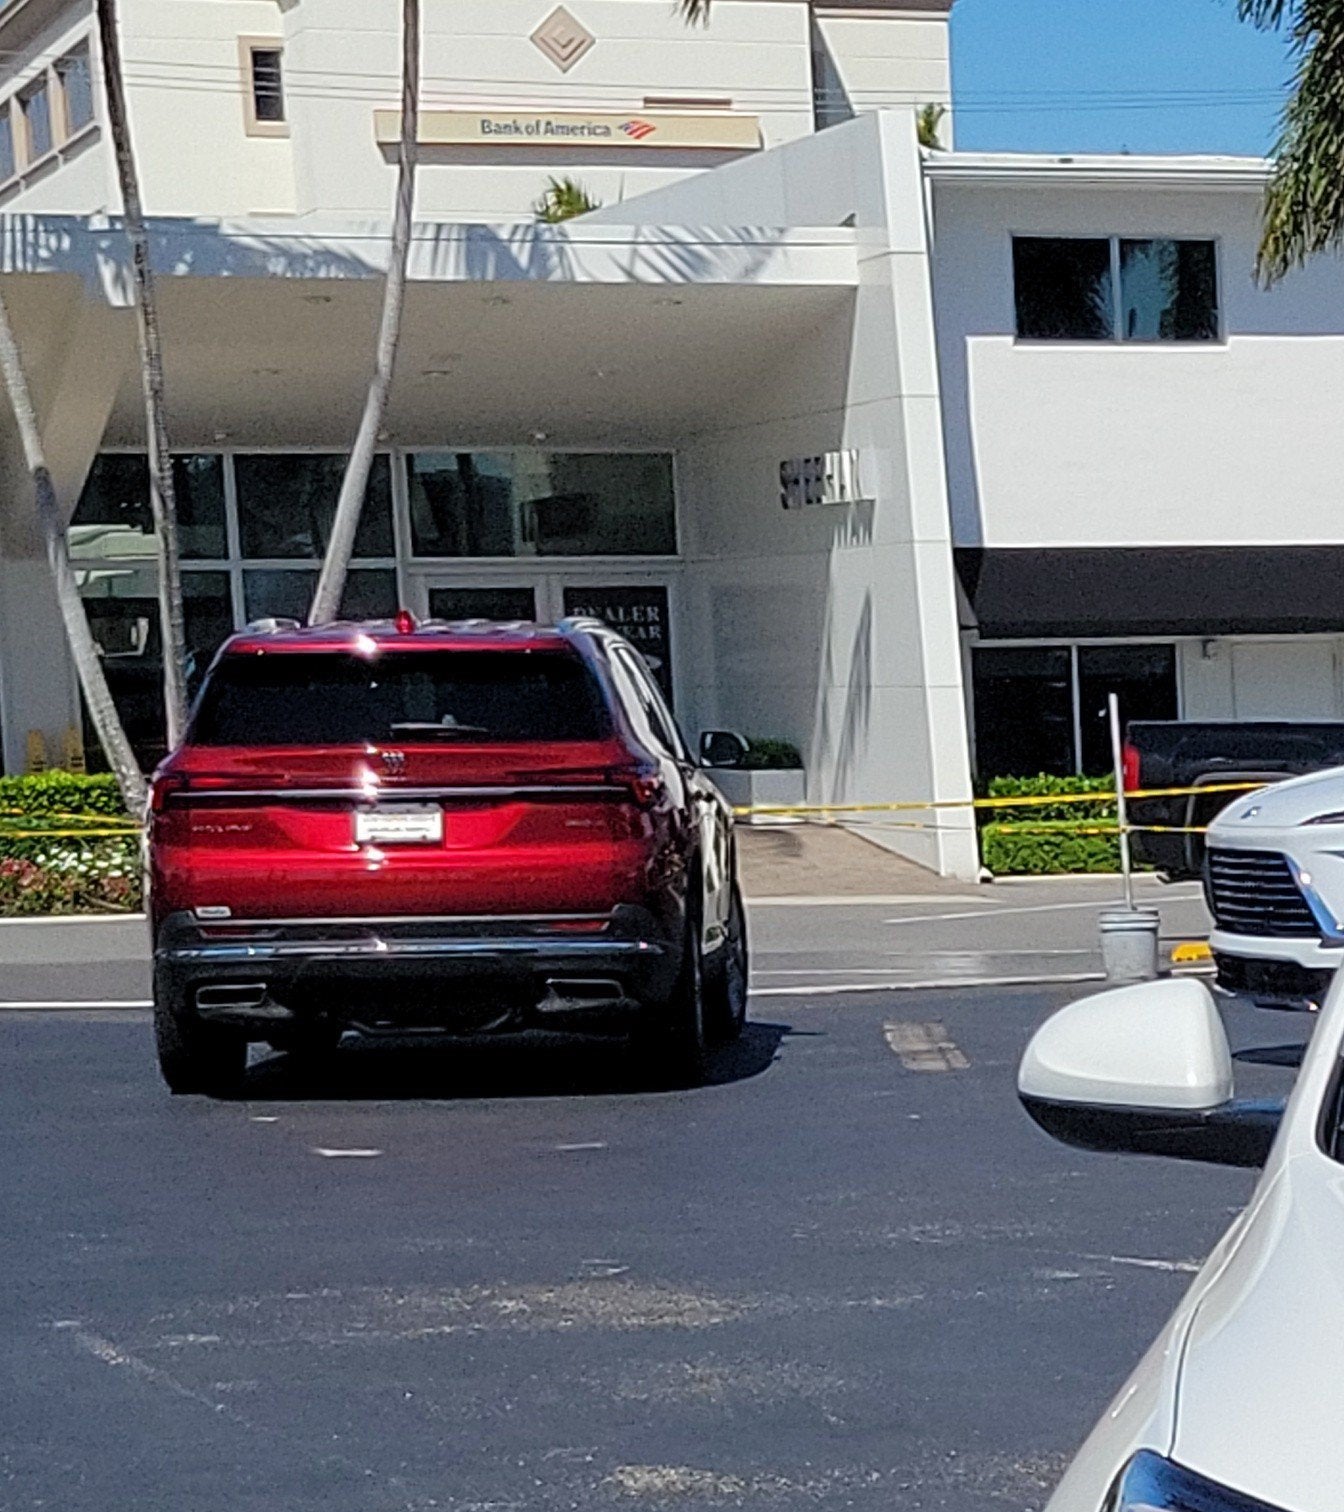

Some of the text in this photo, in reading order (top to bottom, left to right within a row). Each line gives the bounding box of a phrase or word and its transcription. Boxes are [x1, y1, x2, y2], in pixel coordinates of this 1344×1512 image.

[481, 119, 612, 137] Bank of America
